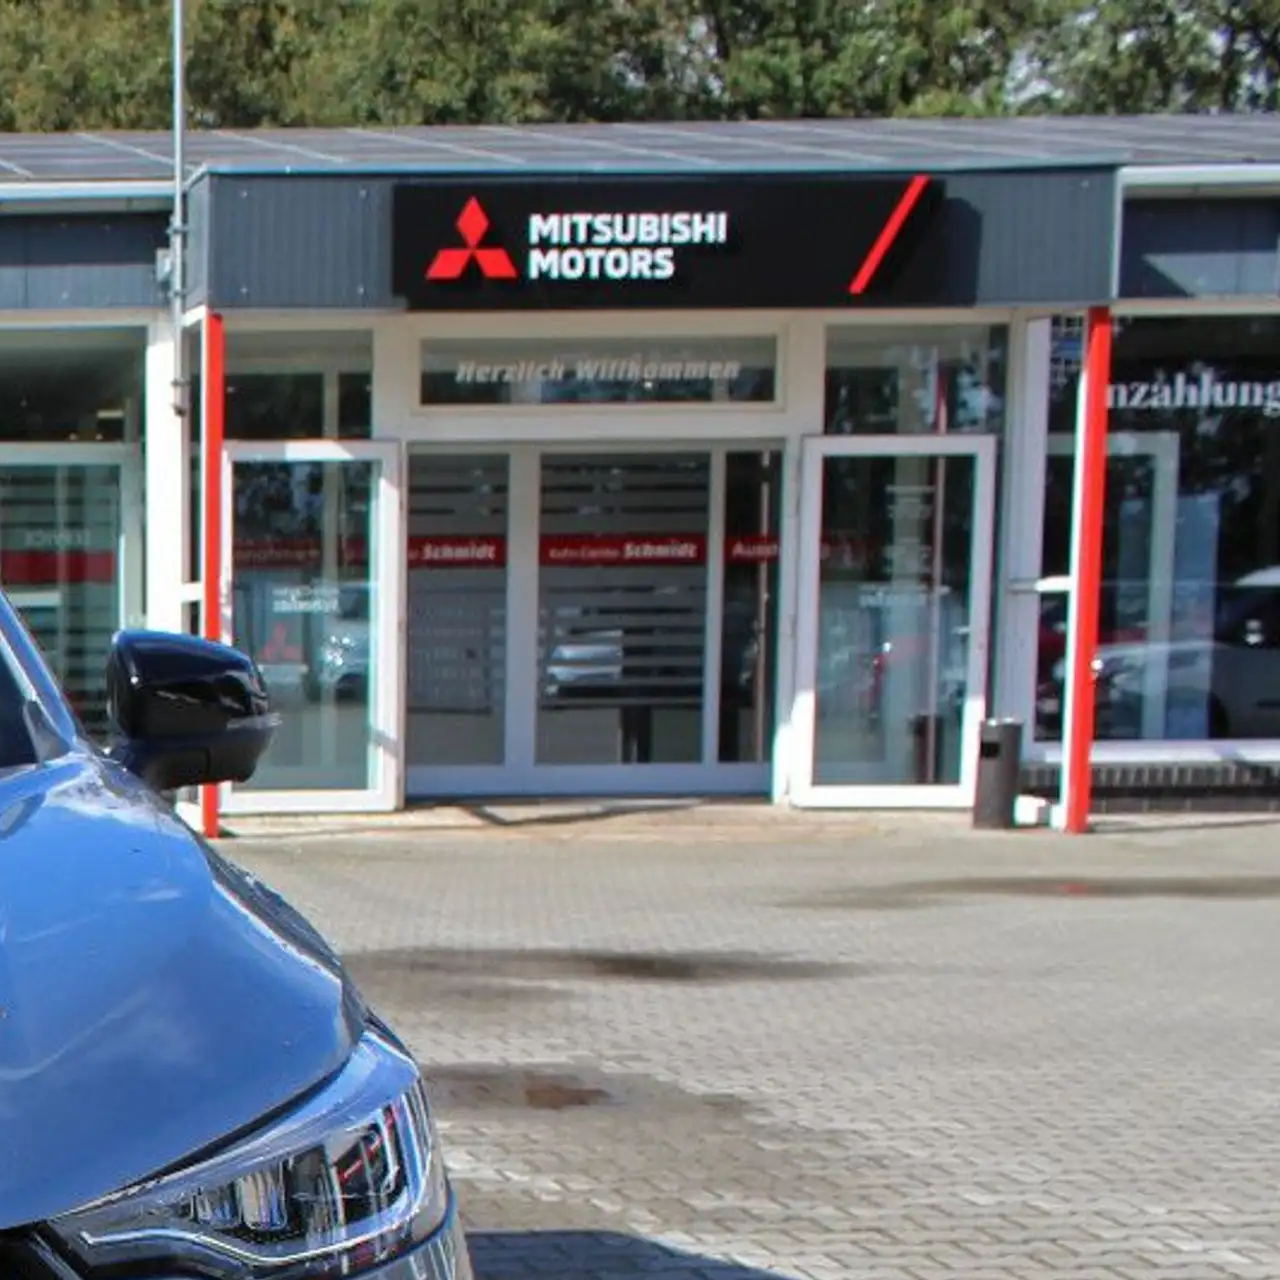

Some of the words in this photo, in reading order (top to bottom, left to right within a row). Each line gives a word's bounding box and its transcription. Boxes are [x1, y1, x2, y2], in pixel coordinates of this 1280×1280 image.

[529, 212, 727, 244] MITSUBISHI
[529, 247, 675, 279] MOTORS
[454, 357, 565, 384] Herzlich
[574, 355, 741, 381] Willkommen
[1107, 372, 1280, 417] nzahlung
[422, 541, 496, 560] Schmidt
[623, 540, 699, 559] Schmidt
